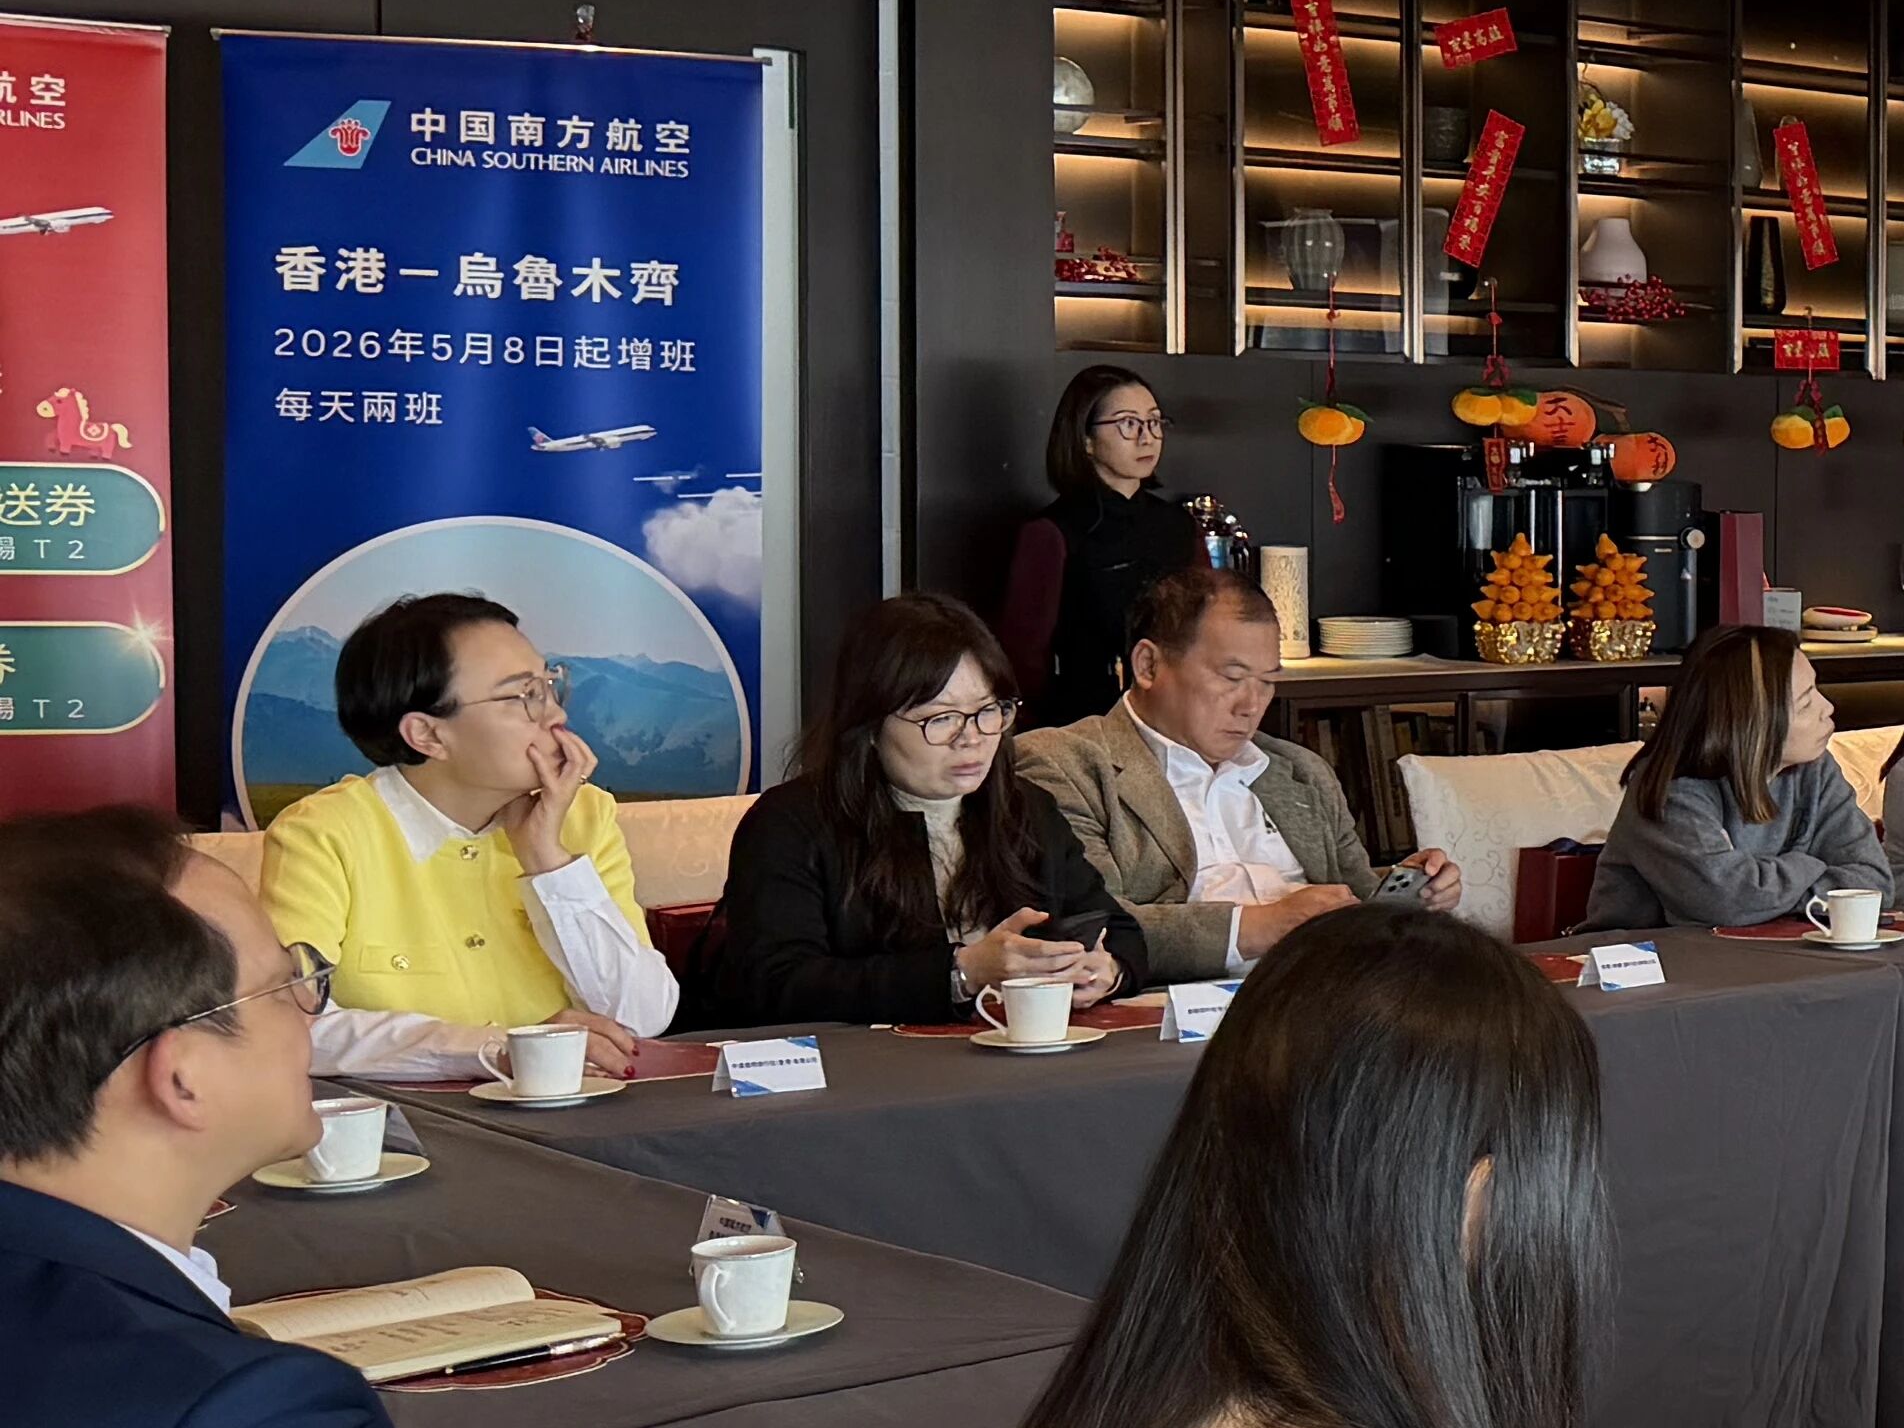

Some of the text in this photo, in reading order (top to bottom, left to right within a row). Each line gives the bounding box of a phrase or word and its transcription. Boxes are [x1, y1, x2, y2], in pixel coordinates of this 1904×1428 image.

[410, 107, 691, 155] 中国南方航空
[410, 147, 689, 179] CHINA SOUTHERN AIRLINES
[274, 327, 697, 373] 2026年5月8日起增班
[275, 387, 444, 426] 每天兩班
